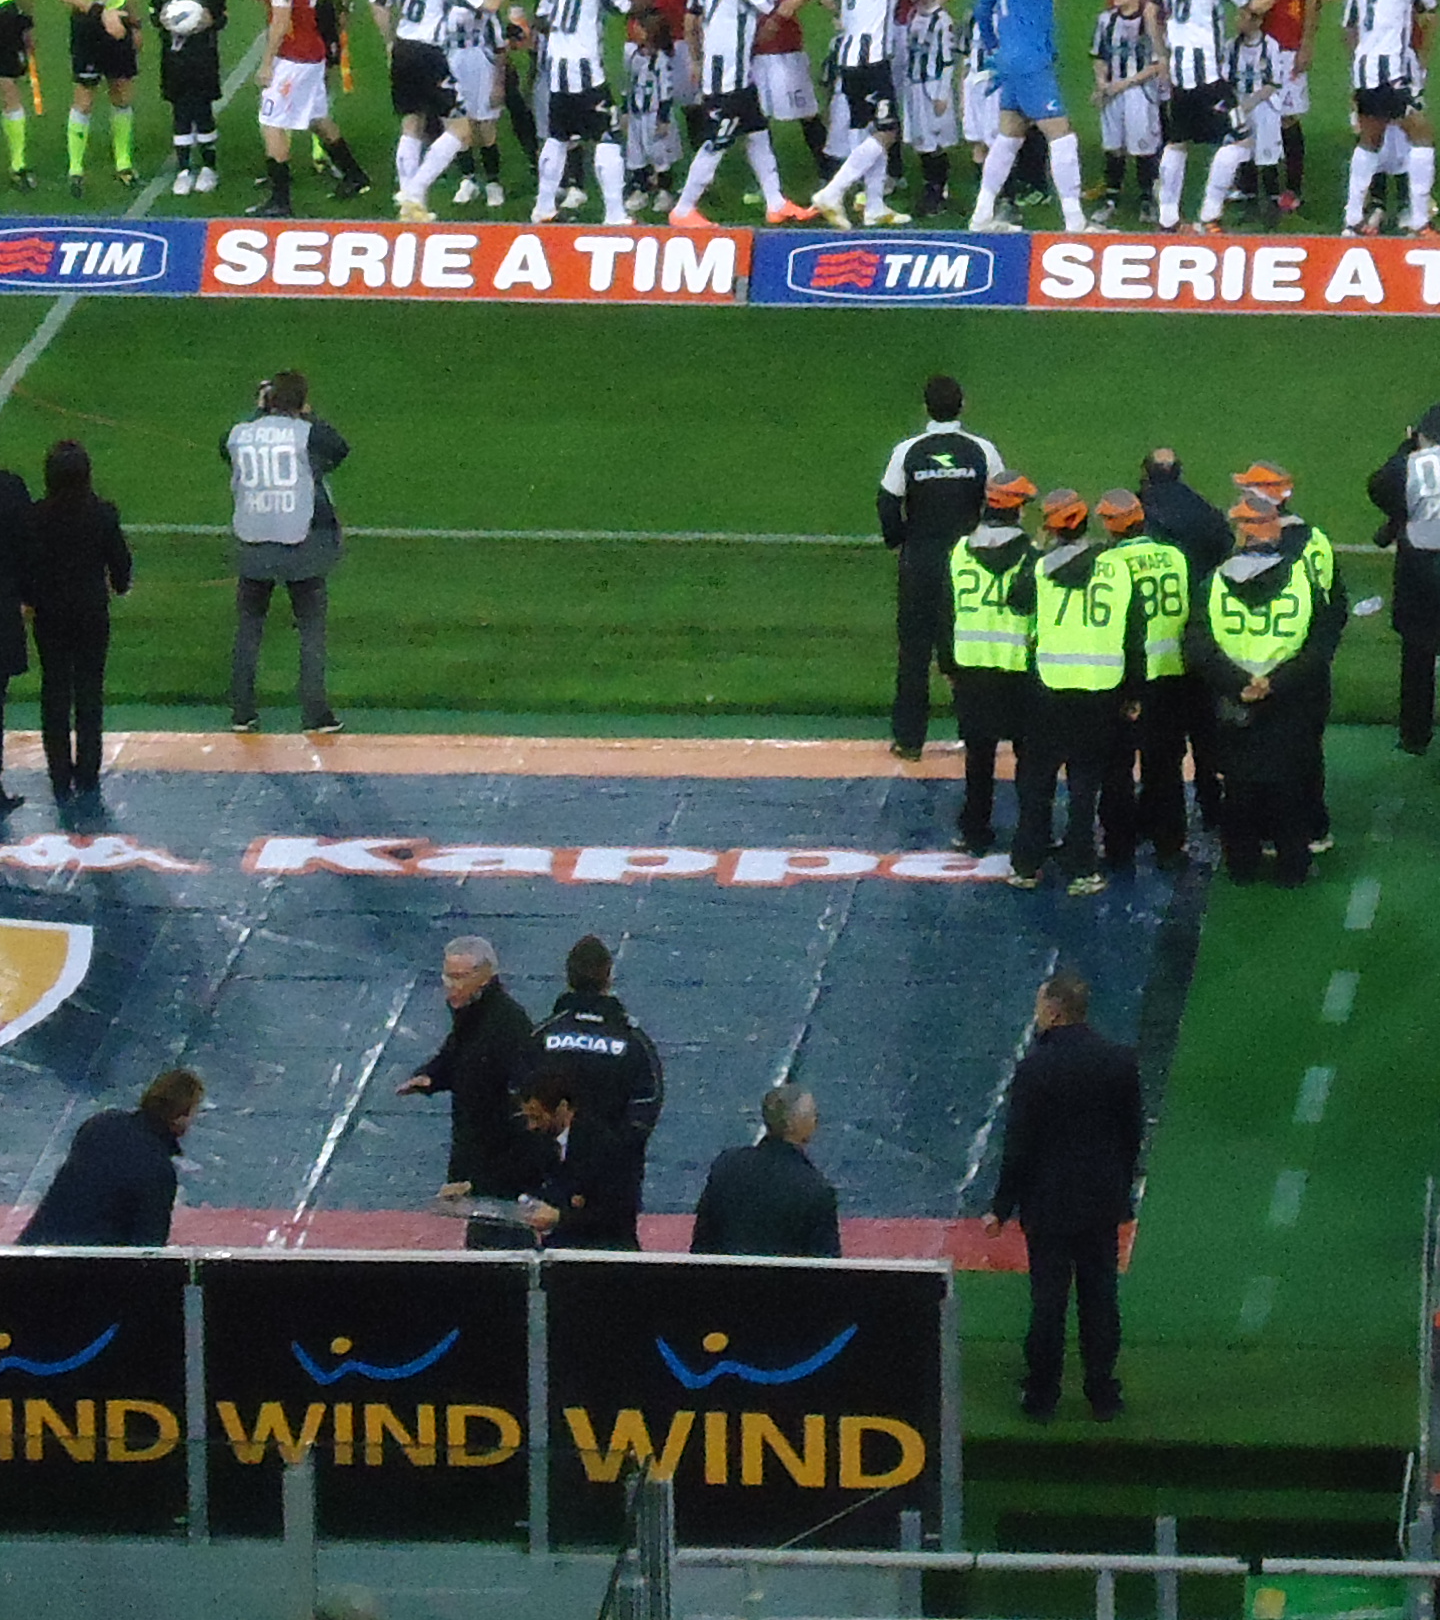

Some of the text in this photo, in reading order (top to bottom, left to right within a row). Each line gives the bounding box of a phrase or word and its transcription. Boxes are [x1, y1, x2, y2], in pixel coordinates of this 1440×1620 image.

[57, 241, 147, 277] TIM
[212, 229, 738, 295] SERIE A TIM
[883, 253, 972, 289] TIM
[1040, 243, 1308, 302] SERIE
[1324, 247, 1386, 305] A
[237, 445, 298, 488] 010
[913, 467, 977, 482] DIADORA
[957, 568, 1019, 616] 24
[244, 836, 1017, 886] Kappa
[545, 1035, 608, 1053] DACIA
[214, 1400, 524, 1468] WIND
[563, 1405, 928, 1492] WIND
